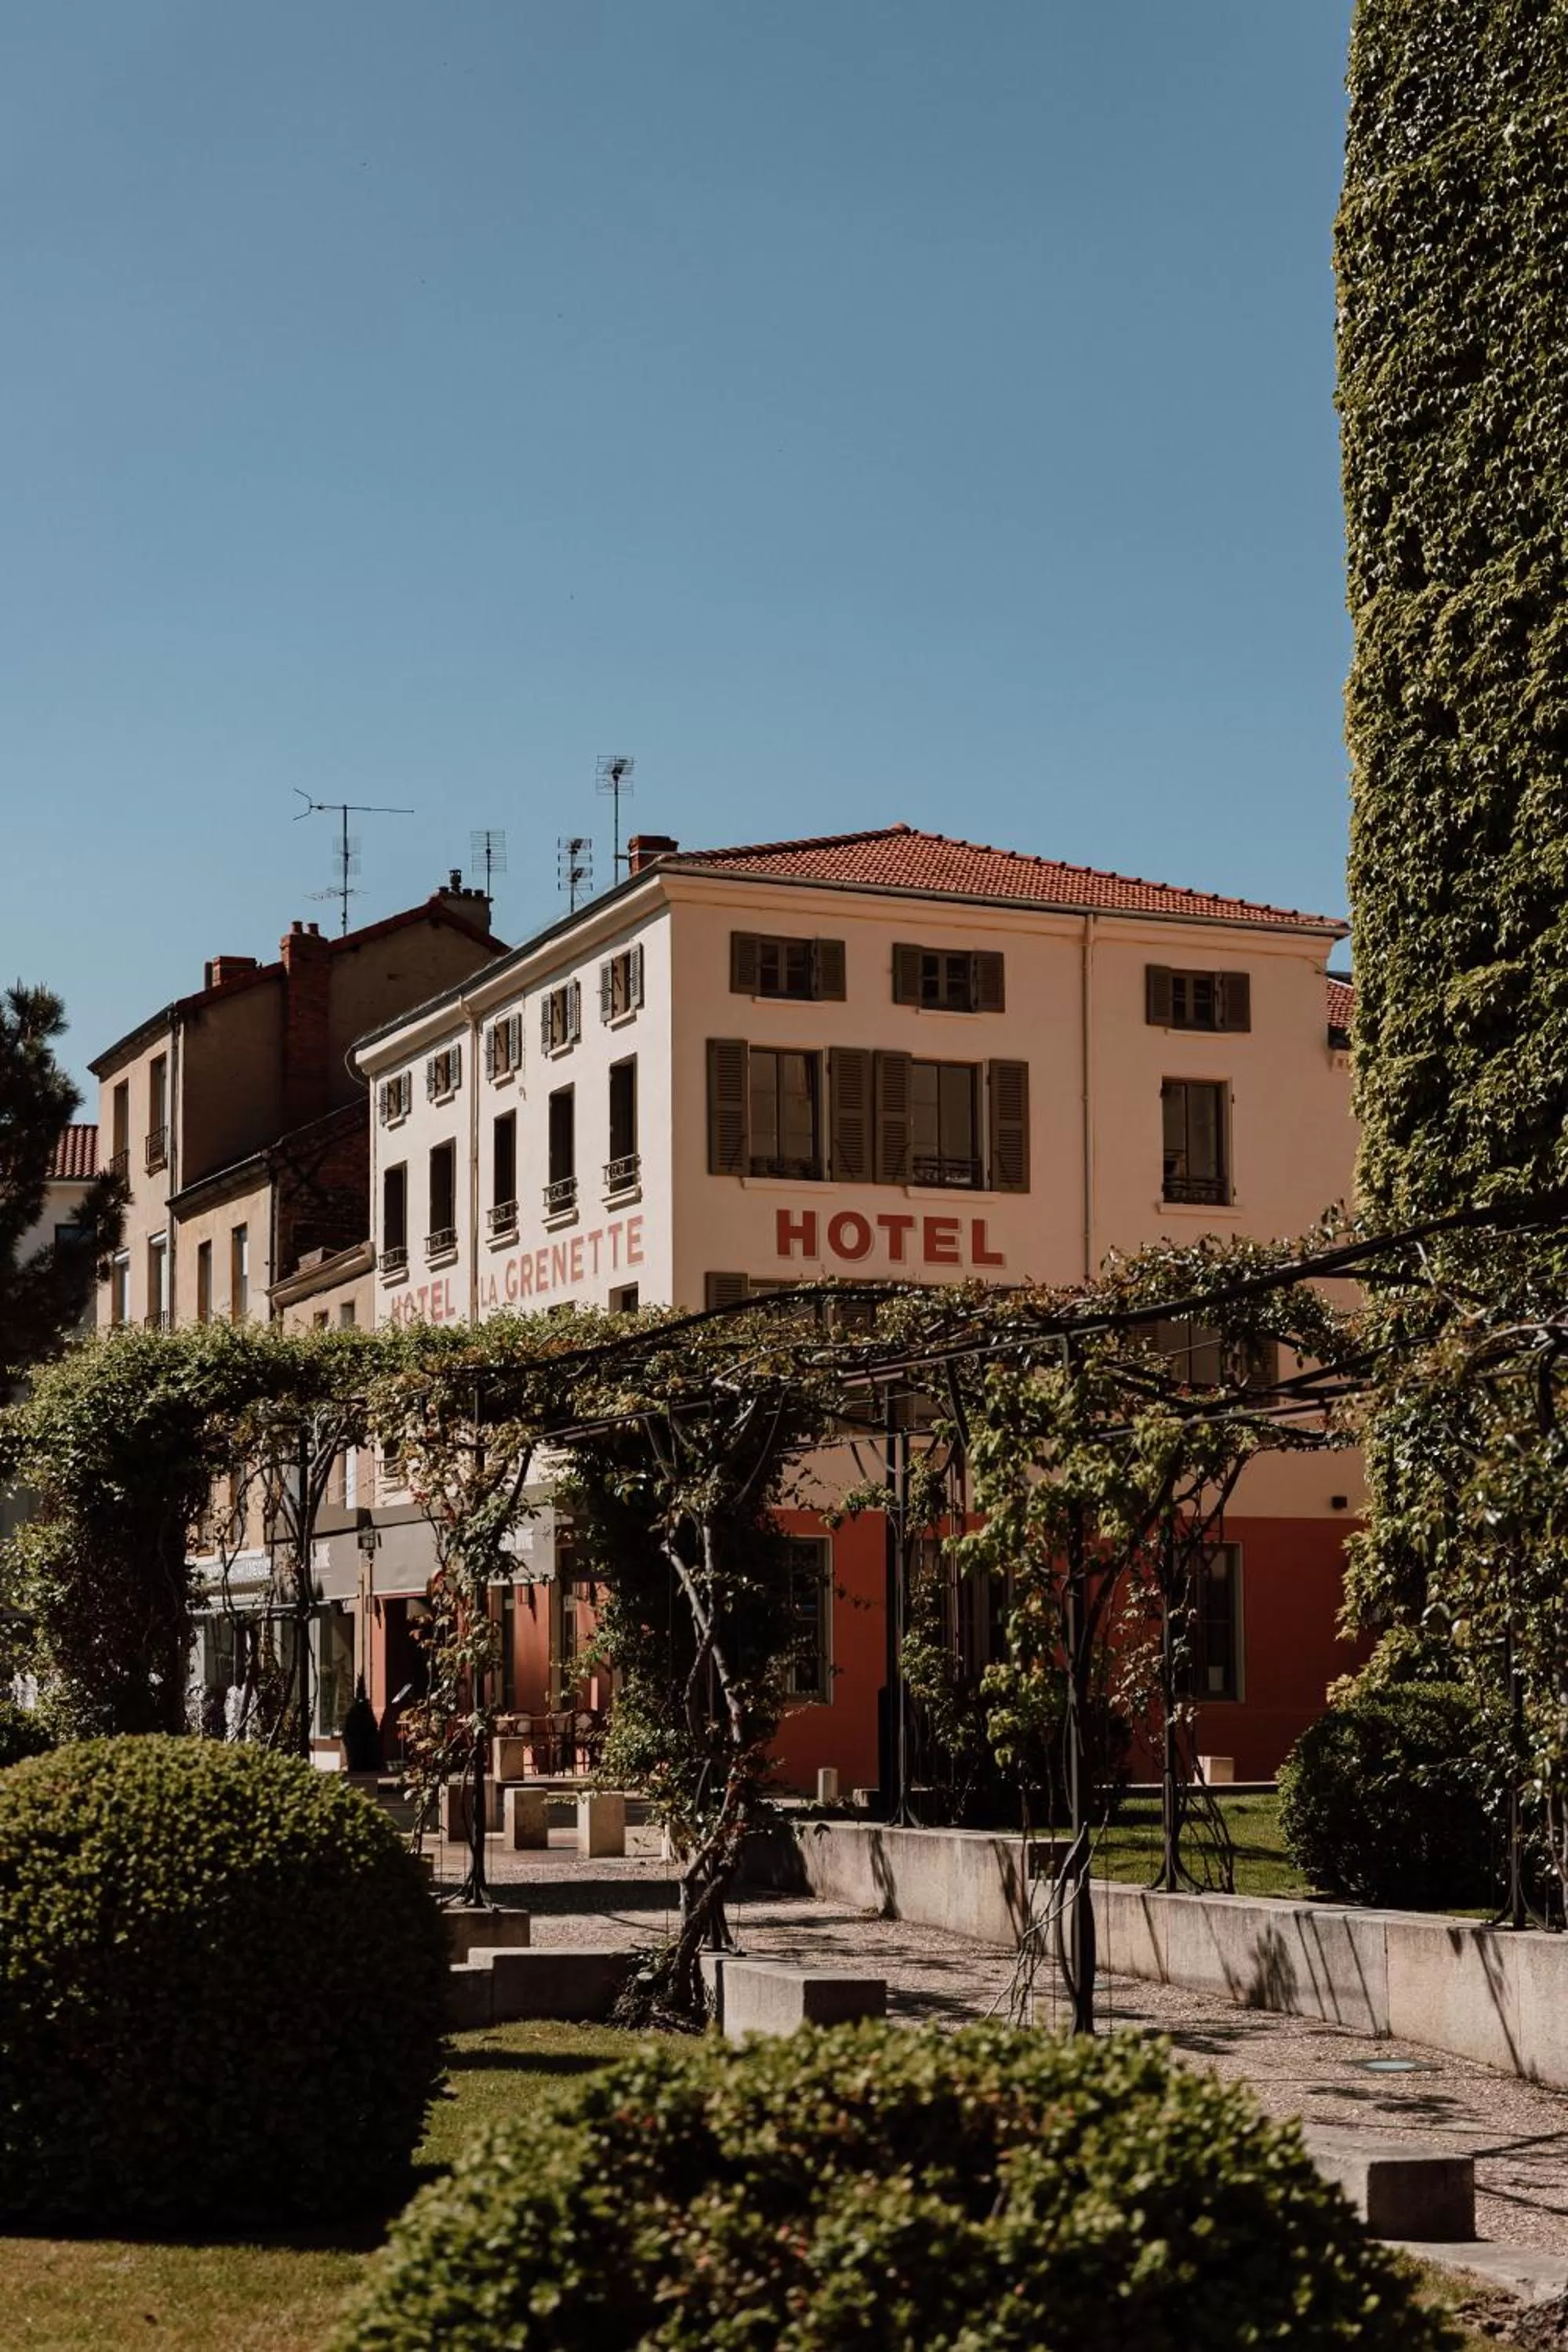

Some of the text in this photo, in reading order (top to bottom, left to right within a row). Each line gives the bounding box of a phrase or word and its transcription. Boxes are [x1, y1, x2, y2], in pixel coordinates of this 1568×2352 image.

[392, 1214, 644, 1327] HOTEL LA GRENETTE
[776, 1209, 1004, 1266] HOTEL
